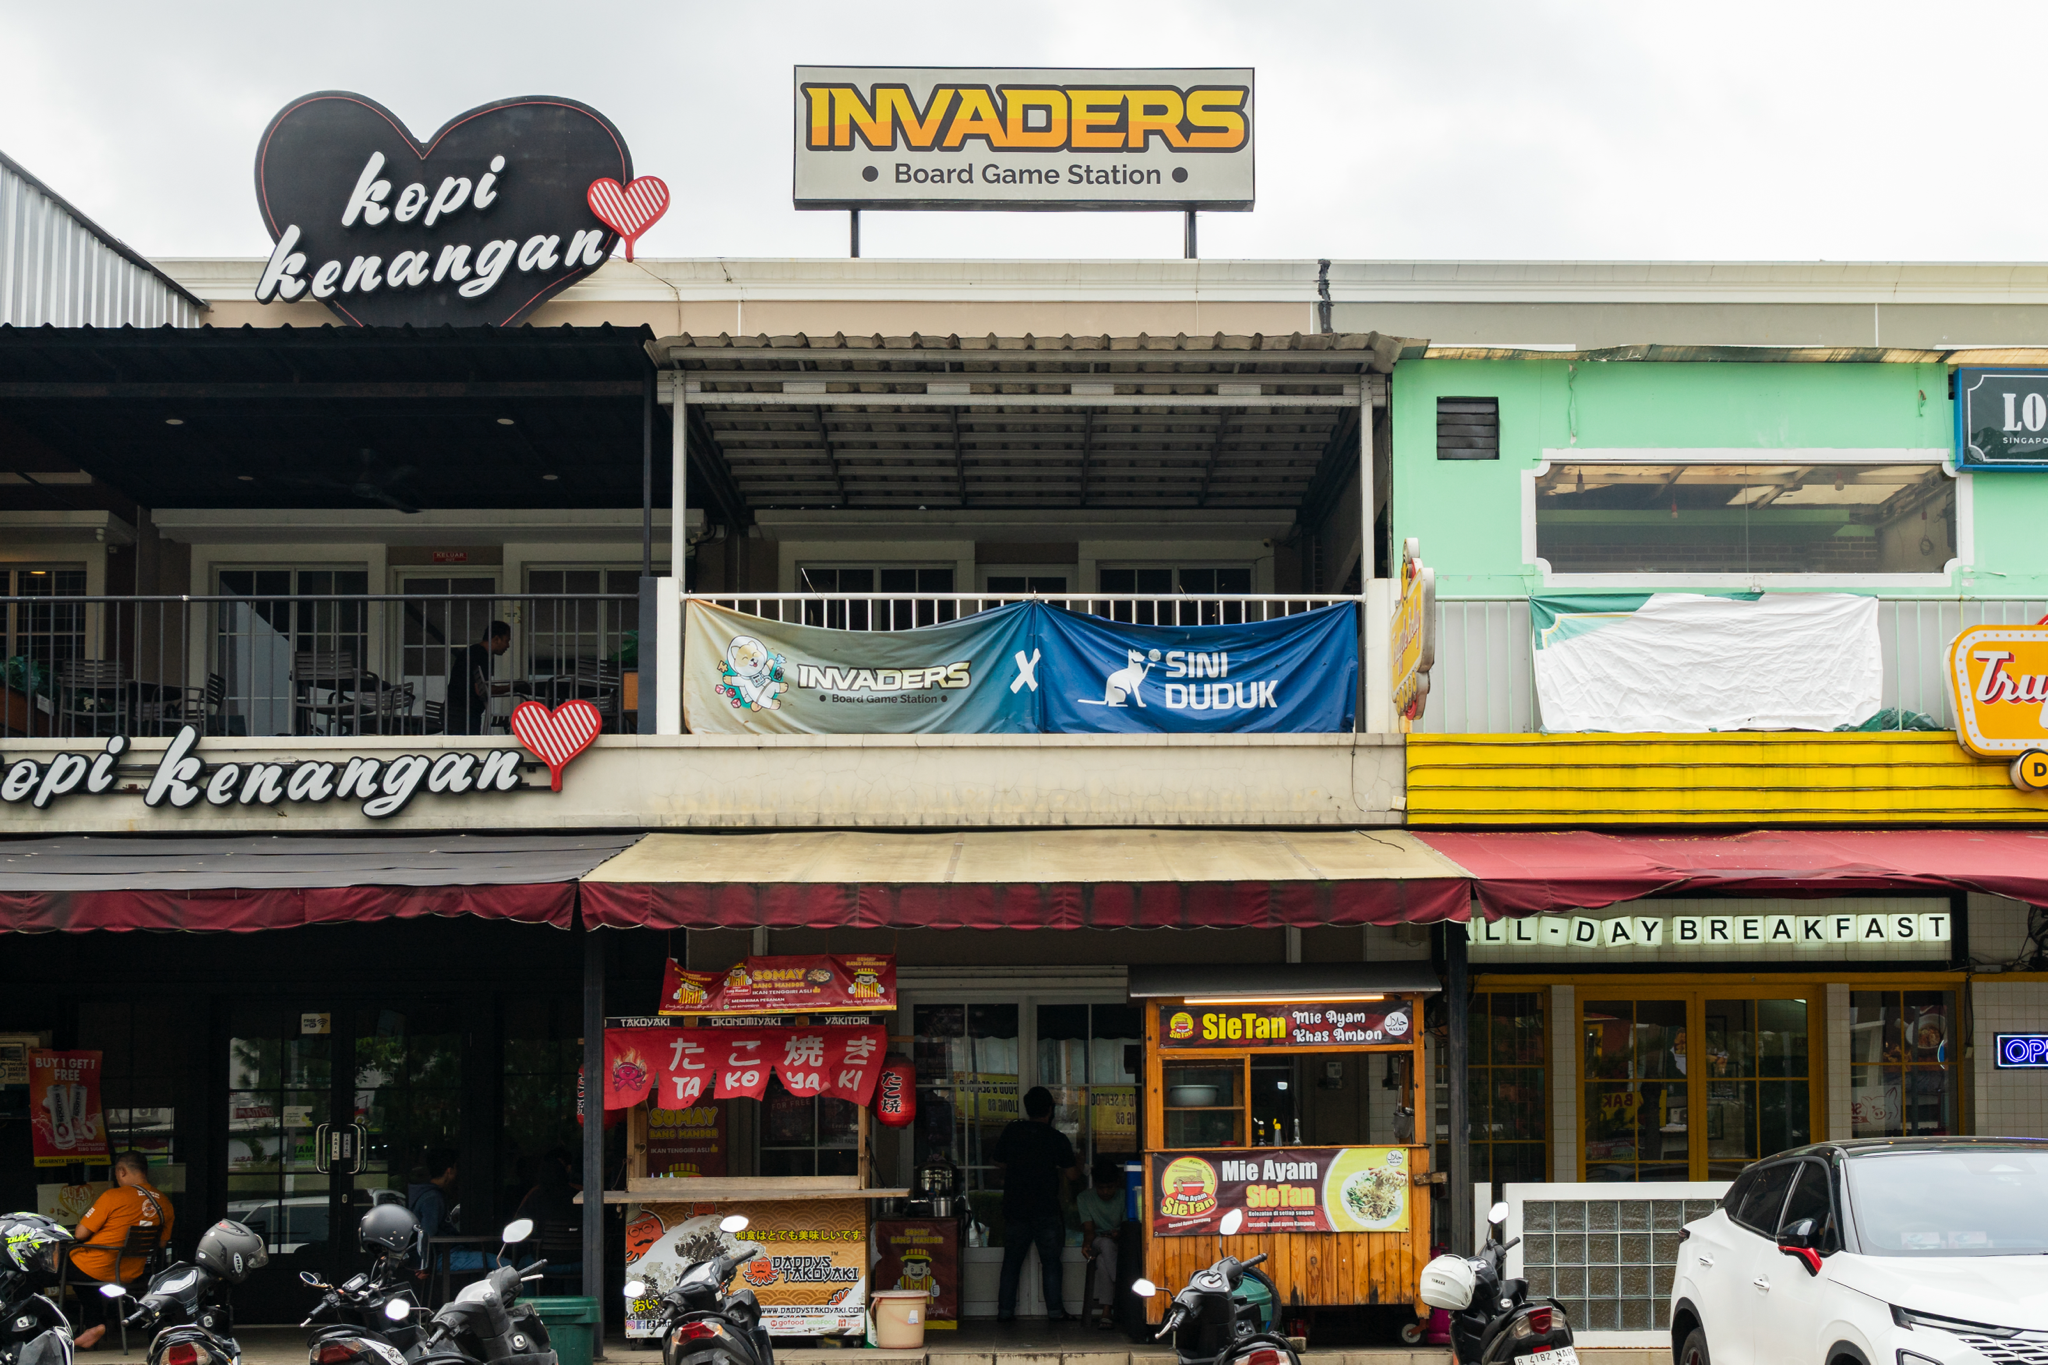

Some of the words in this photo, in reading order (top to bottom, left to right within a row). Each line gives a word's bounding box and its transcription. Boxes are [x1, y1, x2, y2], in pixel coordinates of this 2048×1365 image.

[801, 83, 1249, 153] INVADERS
[895, 162, 973, 184] Board
[982, 163, 1060, 184] Game
[1067, 163, 1161, 185] Station
[341, 150, 506, 228] kopi
[255, 223, 604, 300] kenangan
[2003, 393, 2048, 431] LO
[1010, 648, 1041, 694] X
[1166, 651, 1228, 678] SINI
[798, 661, 971, 691] INVADERS
[832, 693, 864, 704] Board
[867, 694, 898, 704] Game
[900, 693, 938, 704] Station
[1166, 680, 1278, 709] DUDUK
[0, 735, 130, 809] opi
[144, 725, 523, 818] kenangan
[1680, 916, 1946, 940] BREAKFAST
[752, 968, 807, 981] SOMAY
[620, 1018, 670, 1027] TAKOYAKI
[711, 1017, 781, 1026] OKONOMIYAKI
[825, 1016, 870, 1025] YAKITORI
[1202, 1013, 1286, 1040] SieTan
[1292, 1011, 1322, 1024] Mie
[1326, 1010, 1366, 1028] Ayam
[1169, 1030, 1193, 1039] SieTan
[1292, 1028, 1329, 1042] Khas
[1333, 1028, 1382, 1041] Ambon
[669, 1035, 876, 1072] たこ焼き
[2006, 1039, 2048, 1063] OP
[35, 1058, 59, 1068] BUY
[61, 1058, 66, 1068] 1
[69, 1059, 88, 1069] GET
[90, 1059, 95, 1069] 1
[54, 1069, 80, 1081] FREE
[672, 1076, 701, 1099] TA
[725, 1070, 760, 1090] KO
[838, 1069, 863, 1091] KI
[771, 1102, 787, 1110] FOR
[790, 1098, 811, 1107] FREE
[650, 1106, 718, 1127] SOMAY
[649, 1128, 676, 1139] BANG
[677, 1128, 718, 1139] MANDOR
[1222, 1160, 1258, 1181] Mie
[1263, 1160, 1318, 1182] Ayam
[1177, 1193, 1189, 1201] Mie
[1190, 1193, 1208, 1202] Ayam
[1246, 1184, 1316, 1208] SieTan
[1162, 1197, 1215, 1216] SieTan
[735, 1229, 866, 1241] 和食はとても美味しいです。
[890, 1236, 911, 1244] BANG
[912, 1236, 944, 1244] MANDOR
[904, 1228, 930, 1236] SOMAY
[771, 1256, 832, 1269] DADDYS
[783, 1267, 860, 1283] TAKOYAKI
[1431, 1278, 1446, 1286] YAMAHA
[761, 1306, 865, 1315] WWW.DADDYSTAKOYAKI.COM
[778, 1319, 804, 1327] gofood
[1556, 1347, 1574, 1359] NAR
